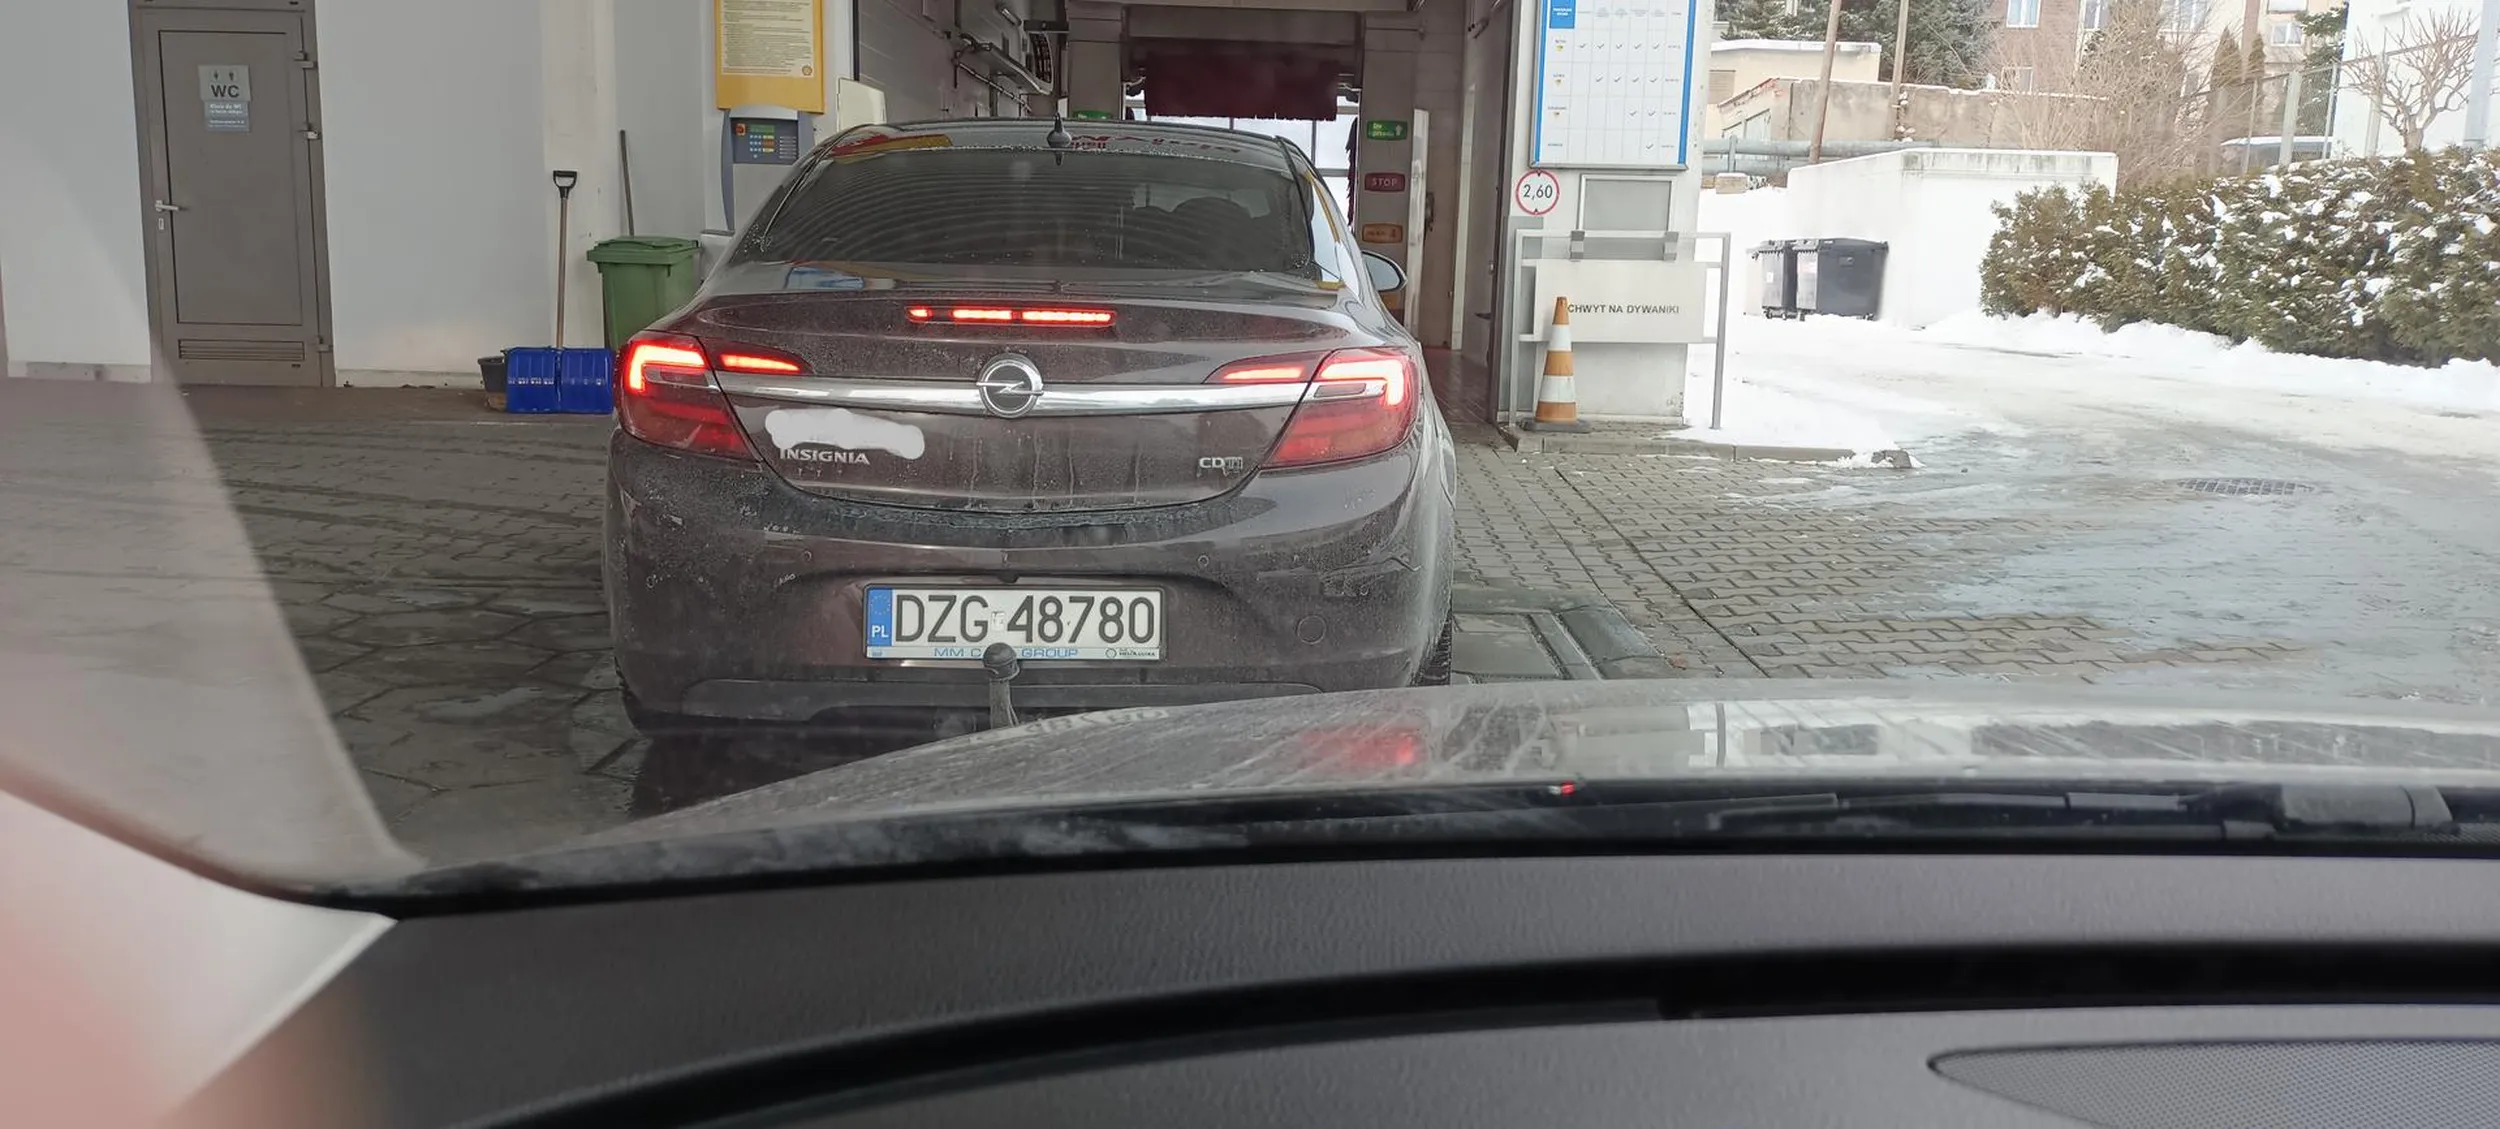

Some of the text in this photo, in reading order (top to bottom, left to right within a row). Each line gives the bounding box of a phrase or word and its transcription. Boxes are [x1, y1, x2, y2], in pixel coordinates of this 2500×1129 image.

[211, 84, 239, 98] WC
[1372, 177, 1398, 187] STOP
[1523, 184, 1553, 200] 2,60
[1567, 304, 1679, 314] CHWYT NA DYWANIKI
[779, 449, 870, 465] INSIGNIA
[895, 594, 1155, 644] DZG 48780
[871, 624, 889, 638] PL
[934, 647, 964, 657] MM
[1022, 647, 1078, 657] GROUP
